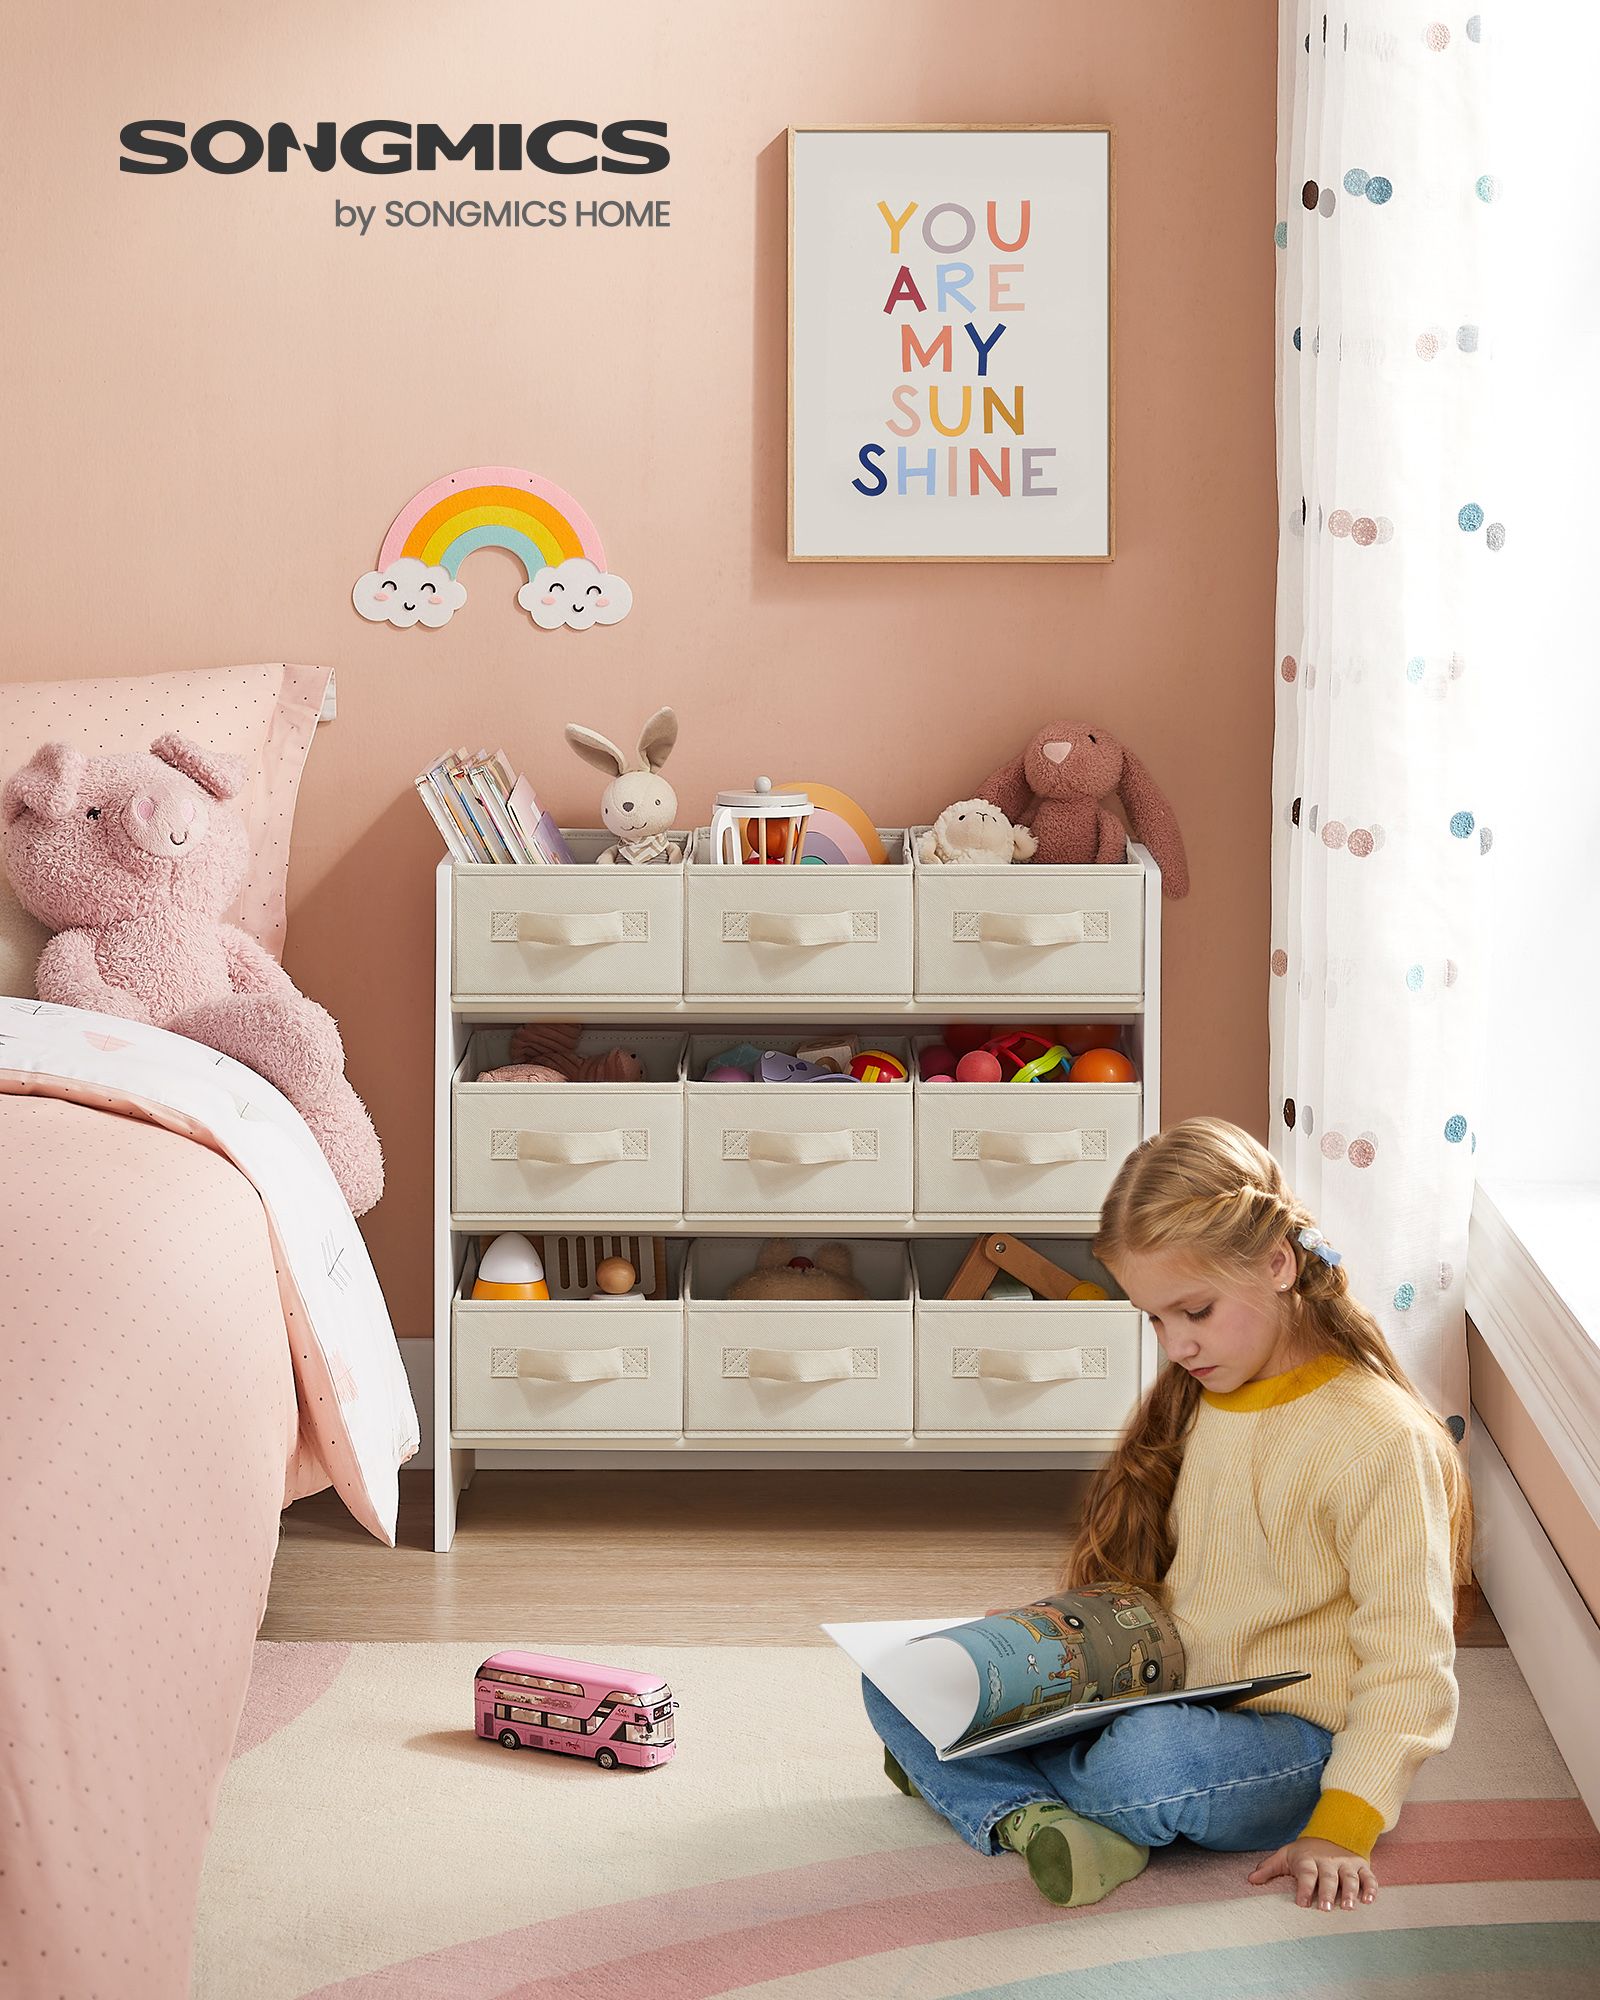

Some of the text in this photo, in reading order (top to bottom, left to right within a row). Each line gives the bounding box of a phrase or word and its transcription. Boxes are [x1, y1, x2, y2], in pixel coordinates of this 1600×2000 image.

[877, 200, 1031, 254] YOU
[883, 262, 1026, 315] ARE
[901, 322, 1007, 377] MY
[885, 384, 1025, 438] SUN
[851, 442, 1058, 497] SHINE
